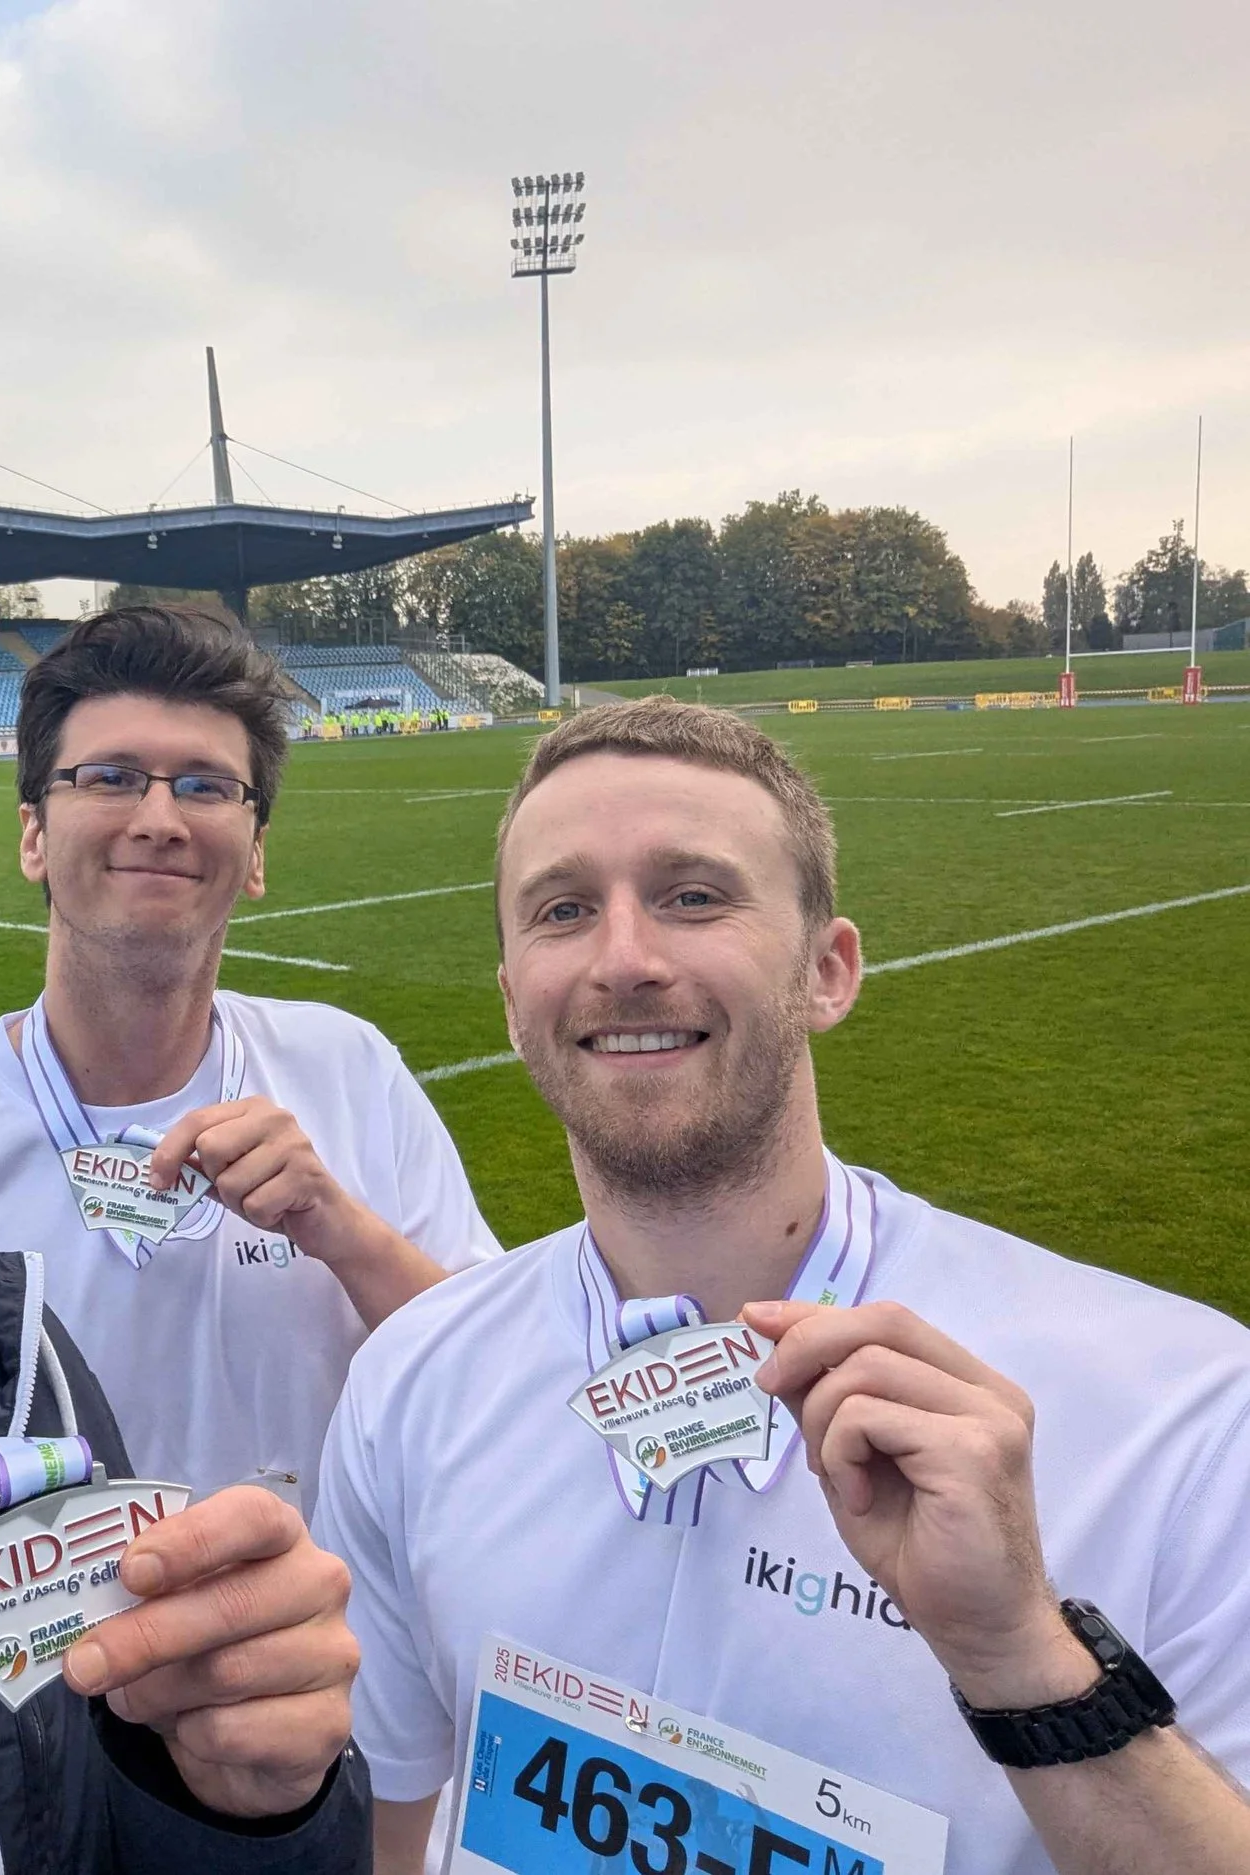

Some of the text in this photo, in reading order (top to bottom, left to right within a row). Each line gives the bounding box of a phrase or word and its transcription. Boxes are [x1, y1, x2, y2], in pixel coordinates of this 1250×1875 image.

[72, 1173, 109, 1188] Villeneuve
[145, 1190, 179, 1206] édition
[105, 1208, 169, 1227] ENVIRONNEMENT
[106, 1200, 137, 1213] FRANCE
[585, 1329, 760, 1418] EKIDEN
[599, 1408, 651, 1431] Villeneuve
[652, 1394, 685, 1413] d'Ascq
[702, 1376, 751, 1402] édition
[664, 1420, 707, 1443] FRANCE
[668, 1414, 757, 1453] ENVIRONNEMENT
[22, 1579, 66, 1603] d'Ascq
[30, 1612, 85, 1643] FRANCE
[494, 1646, 510, 1683] 2025
[513, 1679, 552, 1700] Villeneuve
[514, 1654, 648, 1728] EKIDEN
[687, 1727, 725, 1748] FRANCE
